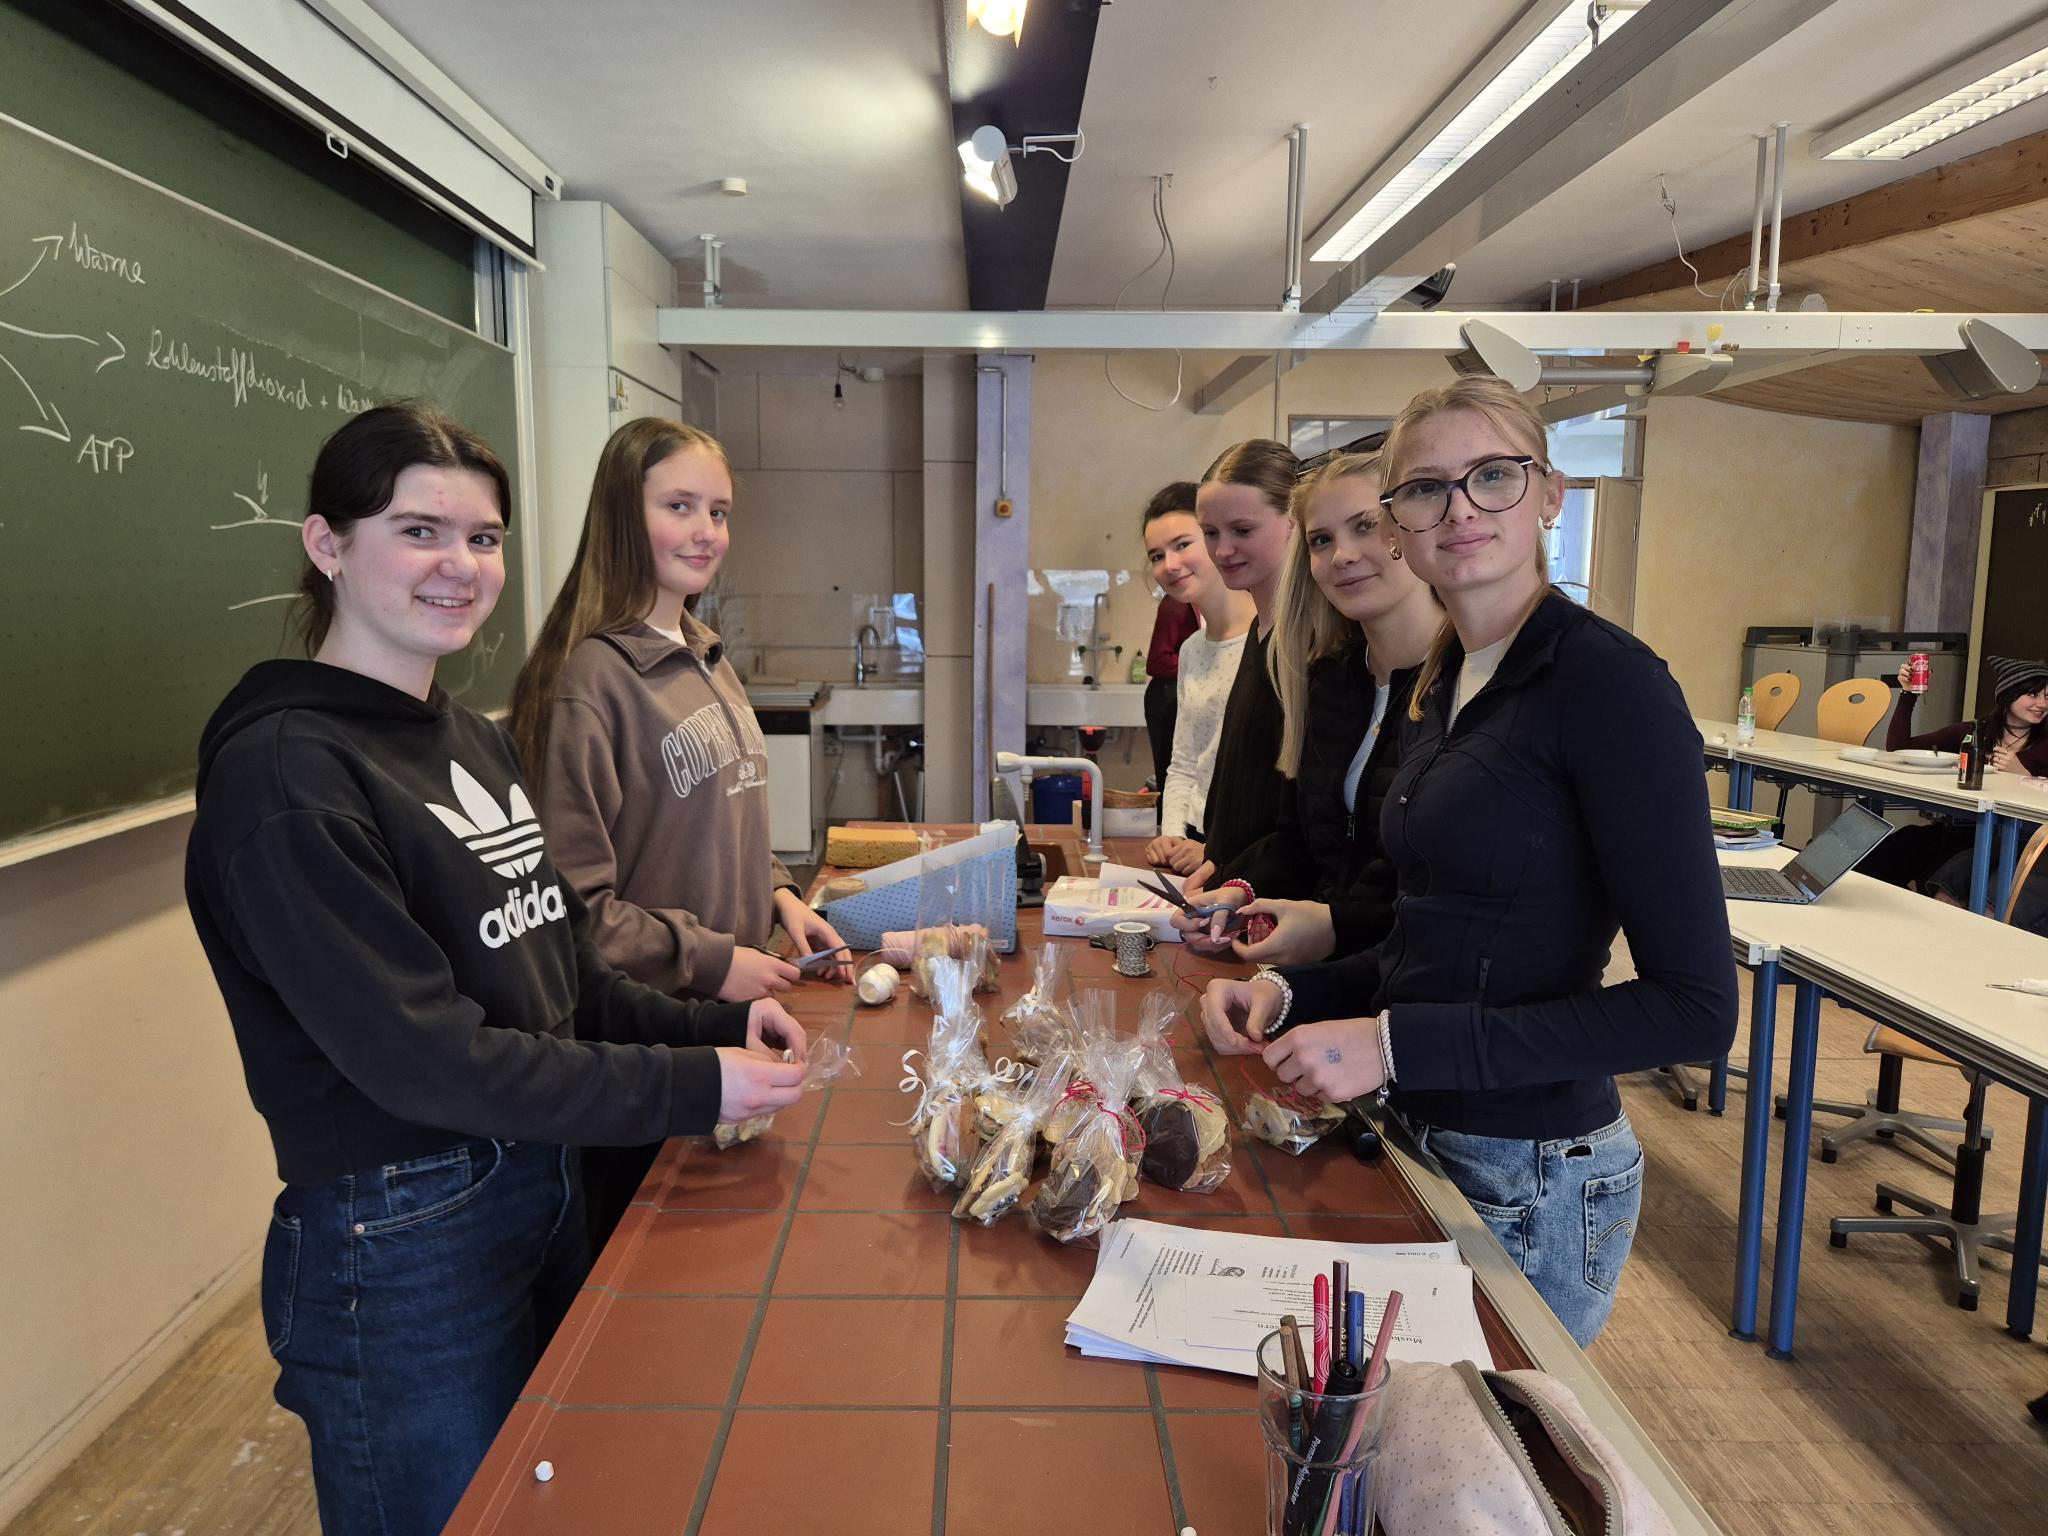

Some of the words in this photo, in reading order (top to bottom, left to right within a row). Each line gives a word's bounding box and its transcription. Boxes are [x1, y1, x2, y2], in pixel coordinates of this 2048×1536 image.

[77, 433, 135, 474] ATP
[479, 880, 567, 949] adida
[1050, 915, 1073, 923] xerox
